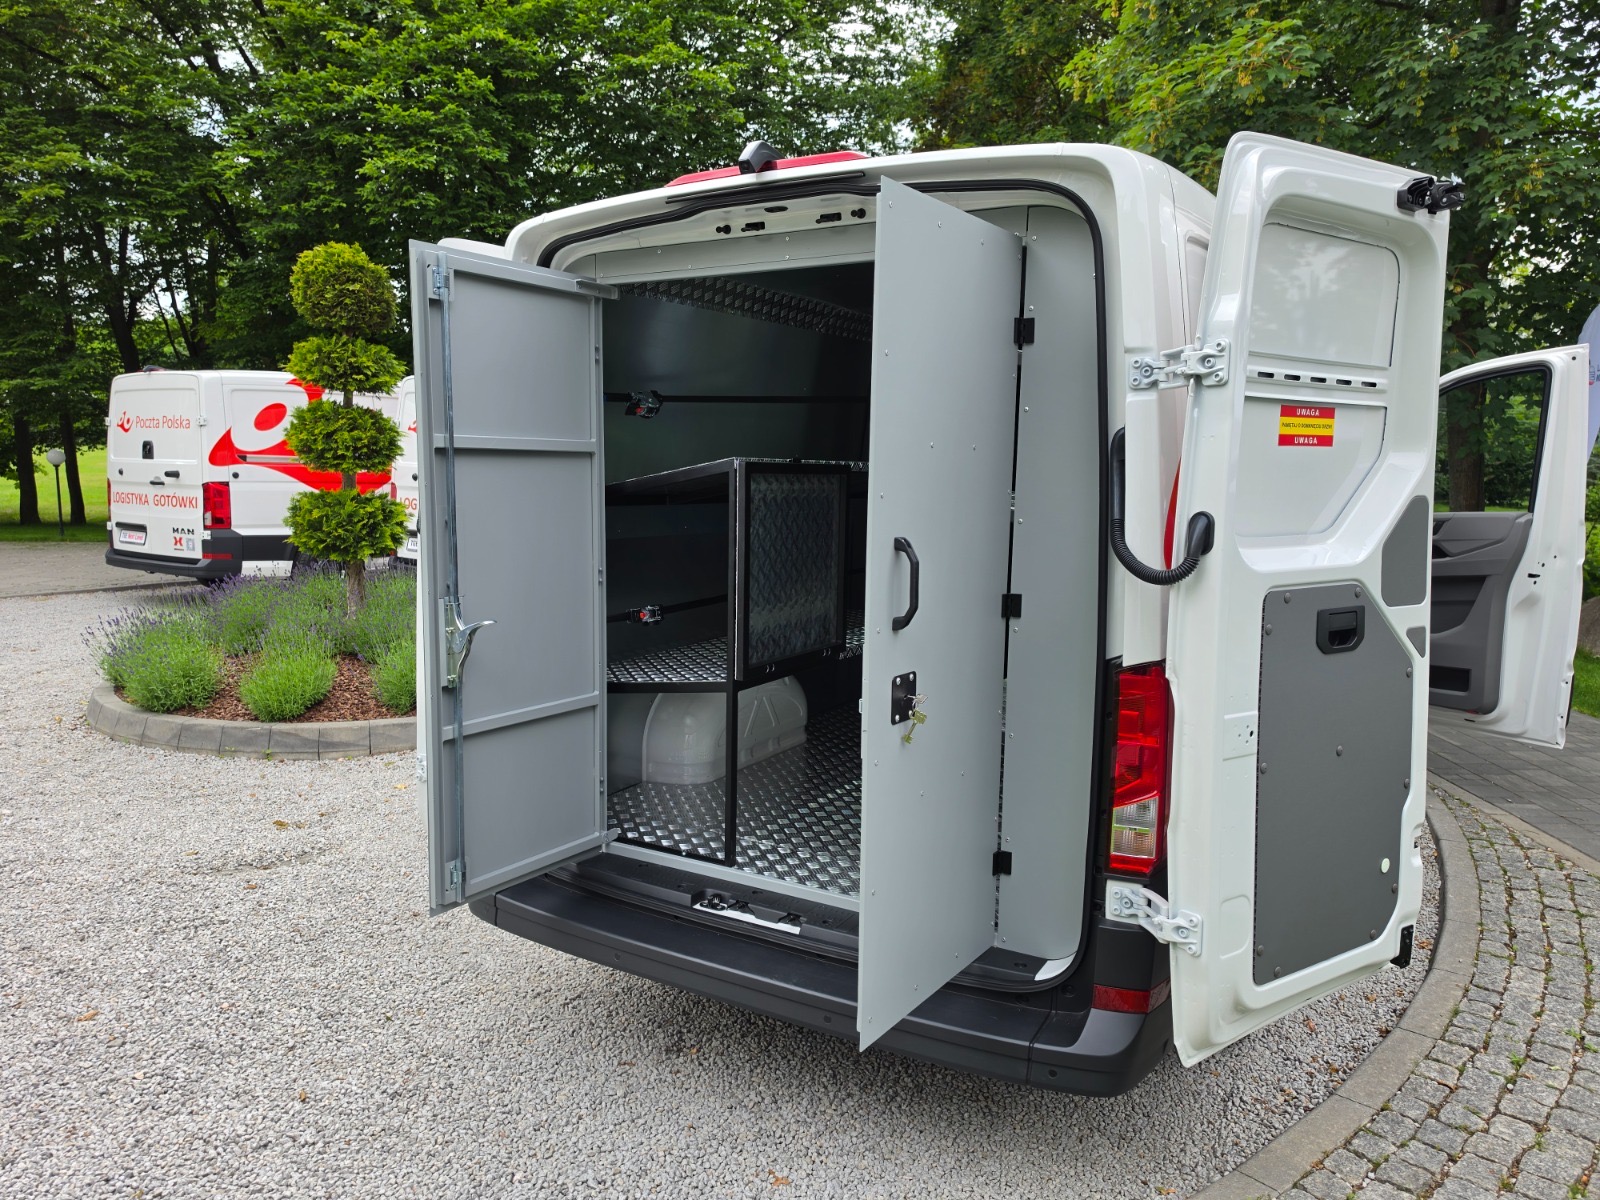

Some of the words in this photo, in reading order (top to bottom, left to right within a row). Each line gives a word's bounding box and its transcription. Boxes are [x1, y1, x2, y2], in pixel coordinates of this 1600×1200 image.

[1296, 408, 1320, 416] UWAGA
[135, 415, 160, 429] Poczta
[162, 414, 191, 429] Polska
[1294, 436, 1318, 444] UWAGA
[112, 491, 150, 506] LOGISTYKA
[153, 491, 198, 509] GOTÓWKI
[172, 527, 195, 535] MAN
